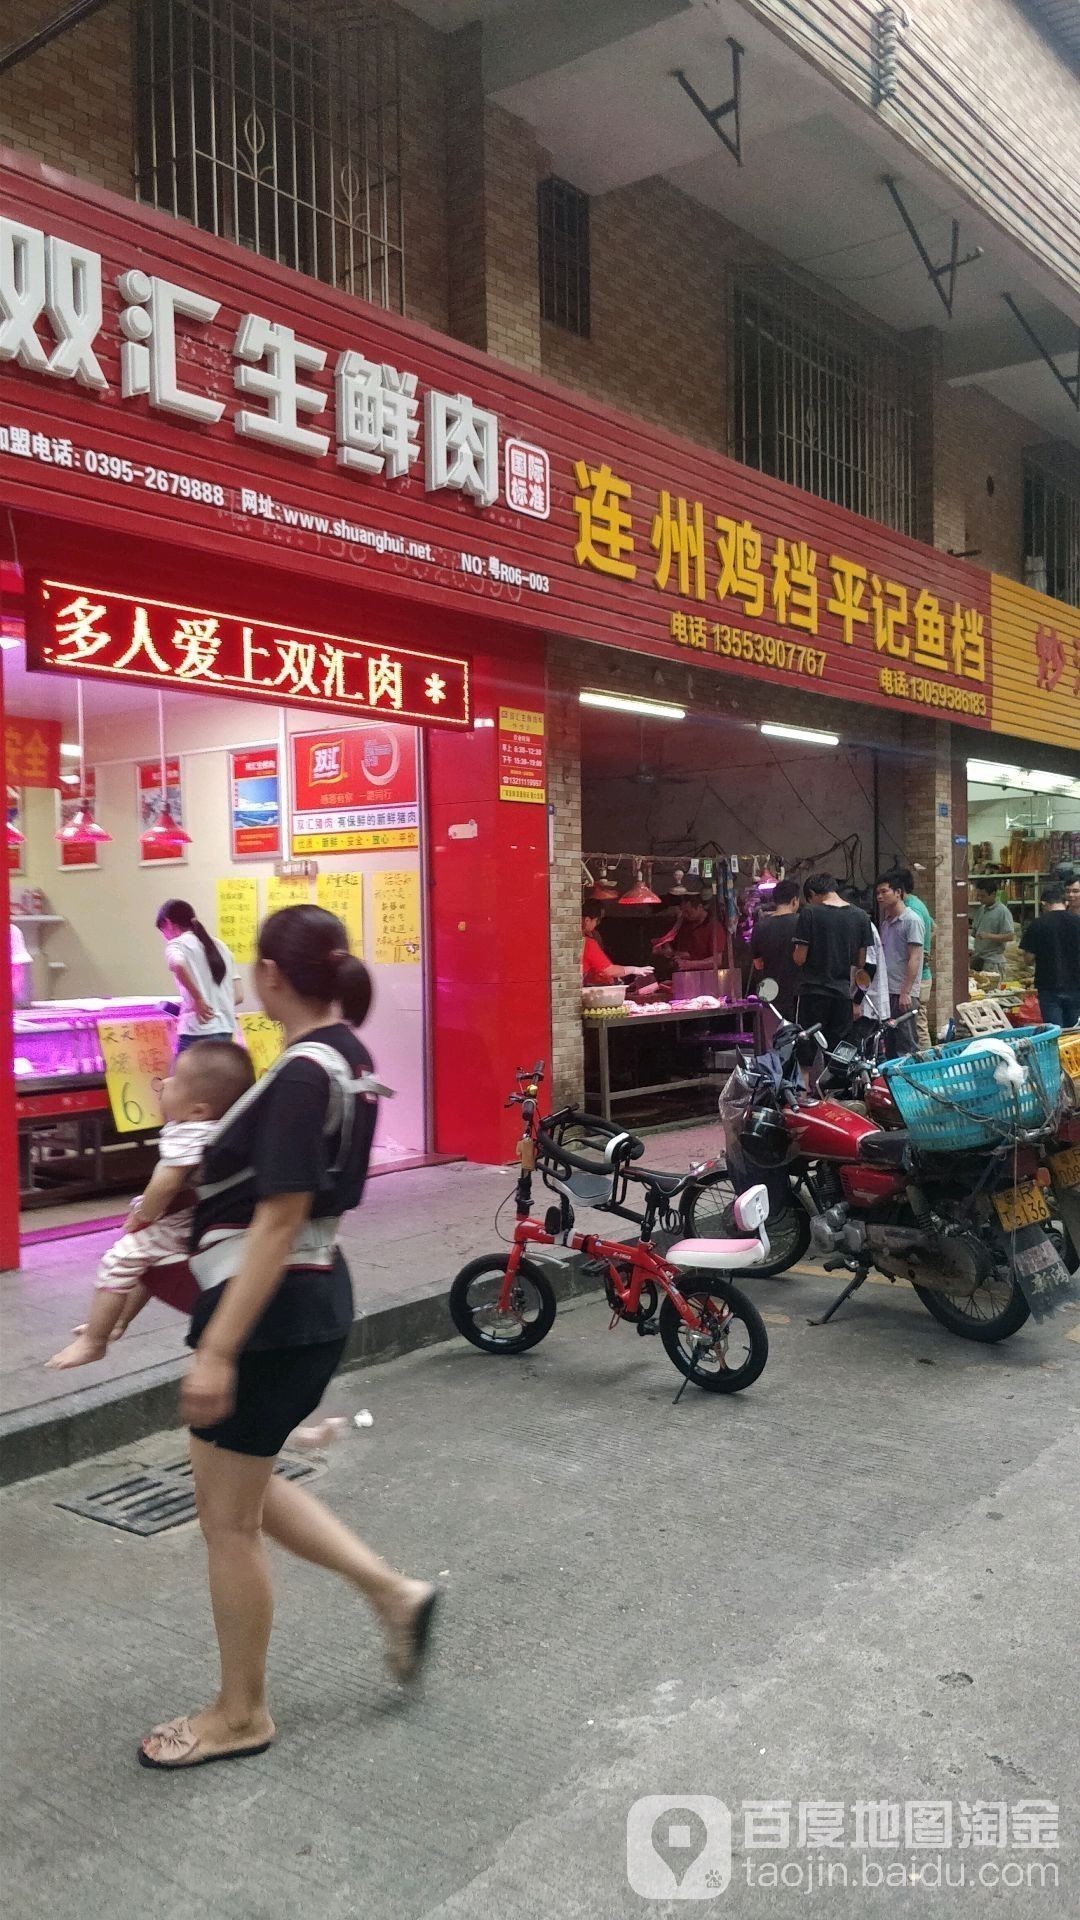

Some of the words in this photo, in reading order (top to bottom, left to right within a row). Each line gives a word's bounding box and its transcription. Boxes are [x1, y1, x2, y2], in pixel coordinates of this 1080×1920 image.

[0, 216, 499, 507] 双汇生鲜肉
[511, 476, 545, 512] 标准
